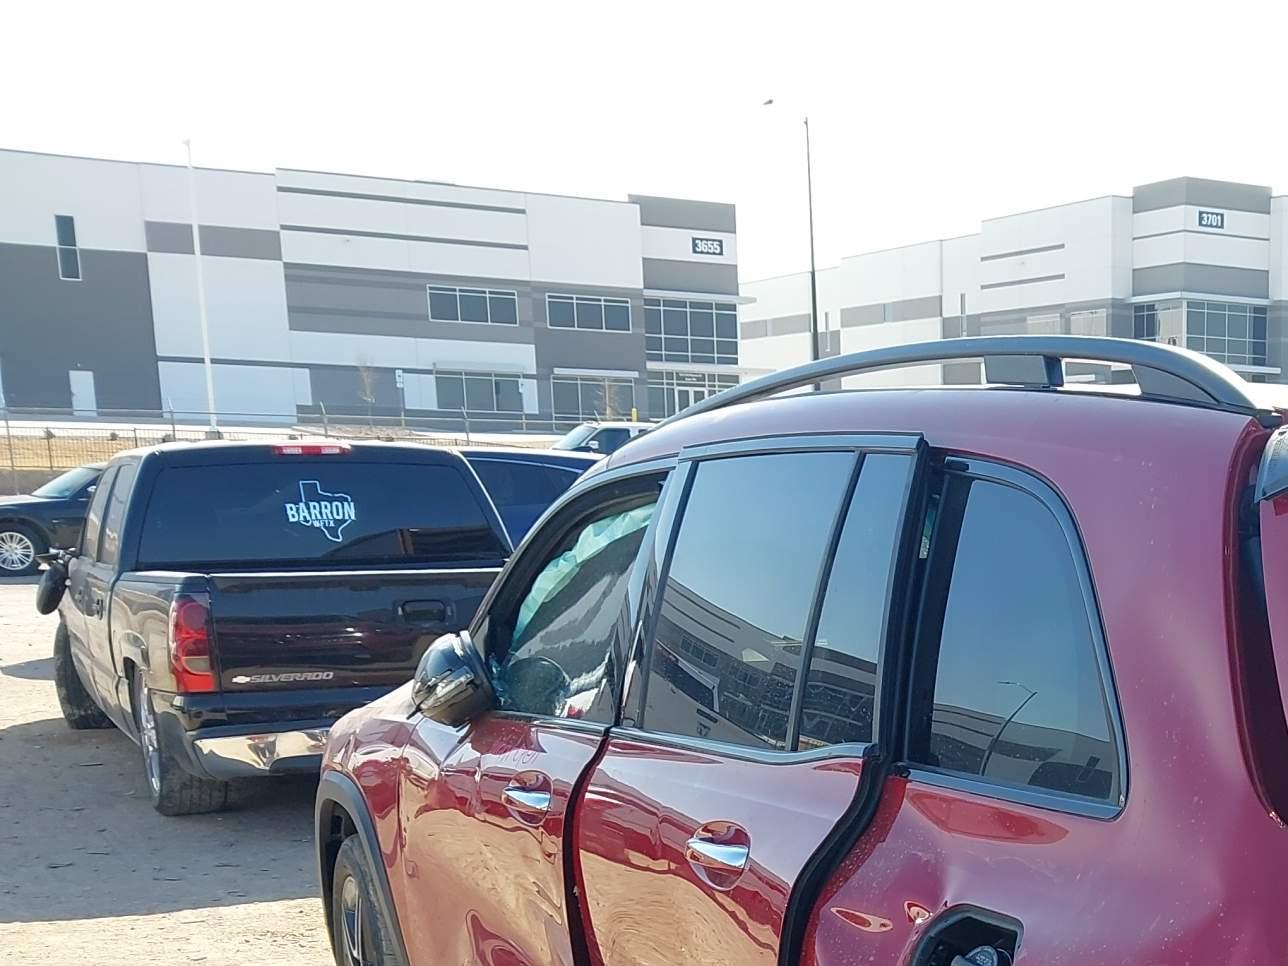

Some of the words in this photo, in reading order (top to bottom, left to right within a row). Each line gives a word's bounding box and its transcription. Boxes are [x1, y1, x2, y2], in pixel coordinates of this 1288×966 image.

[1201, 213, 1221, 227] 3701
[695, 239, 721, 253] 3655
[284, 501, 356, 522] BARRON
[250, 671, 334, 683] SILVERADO
